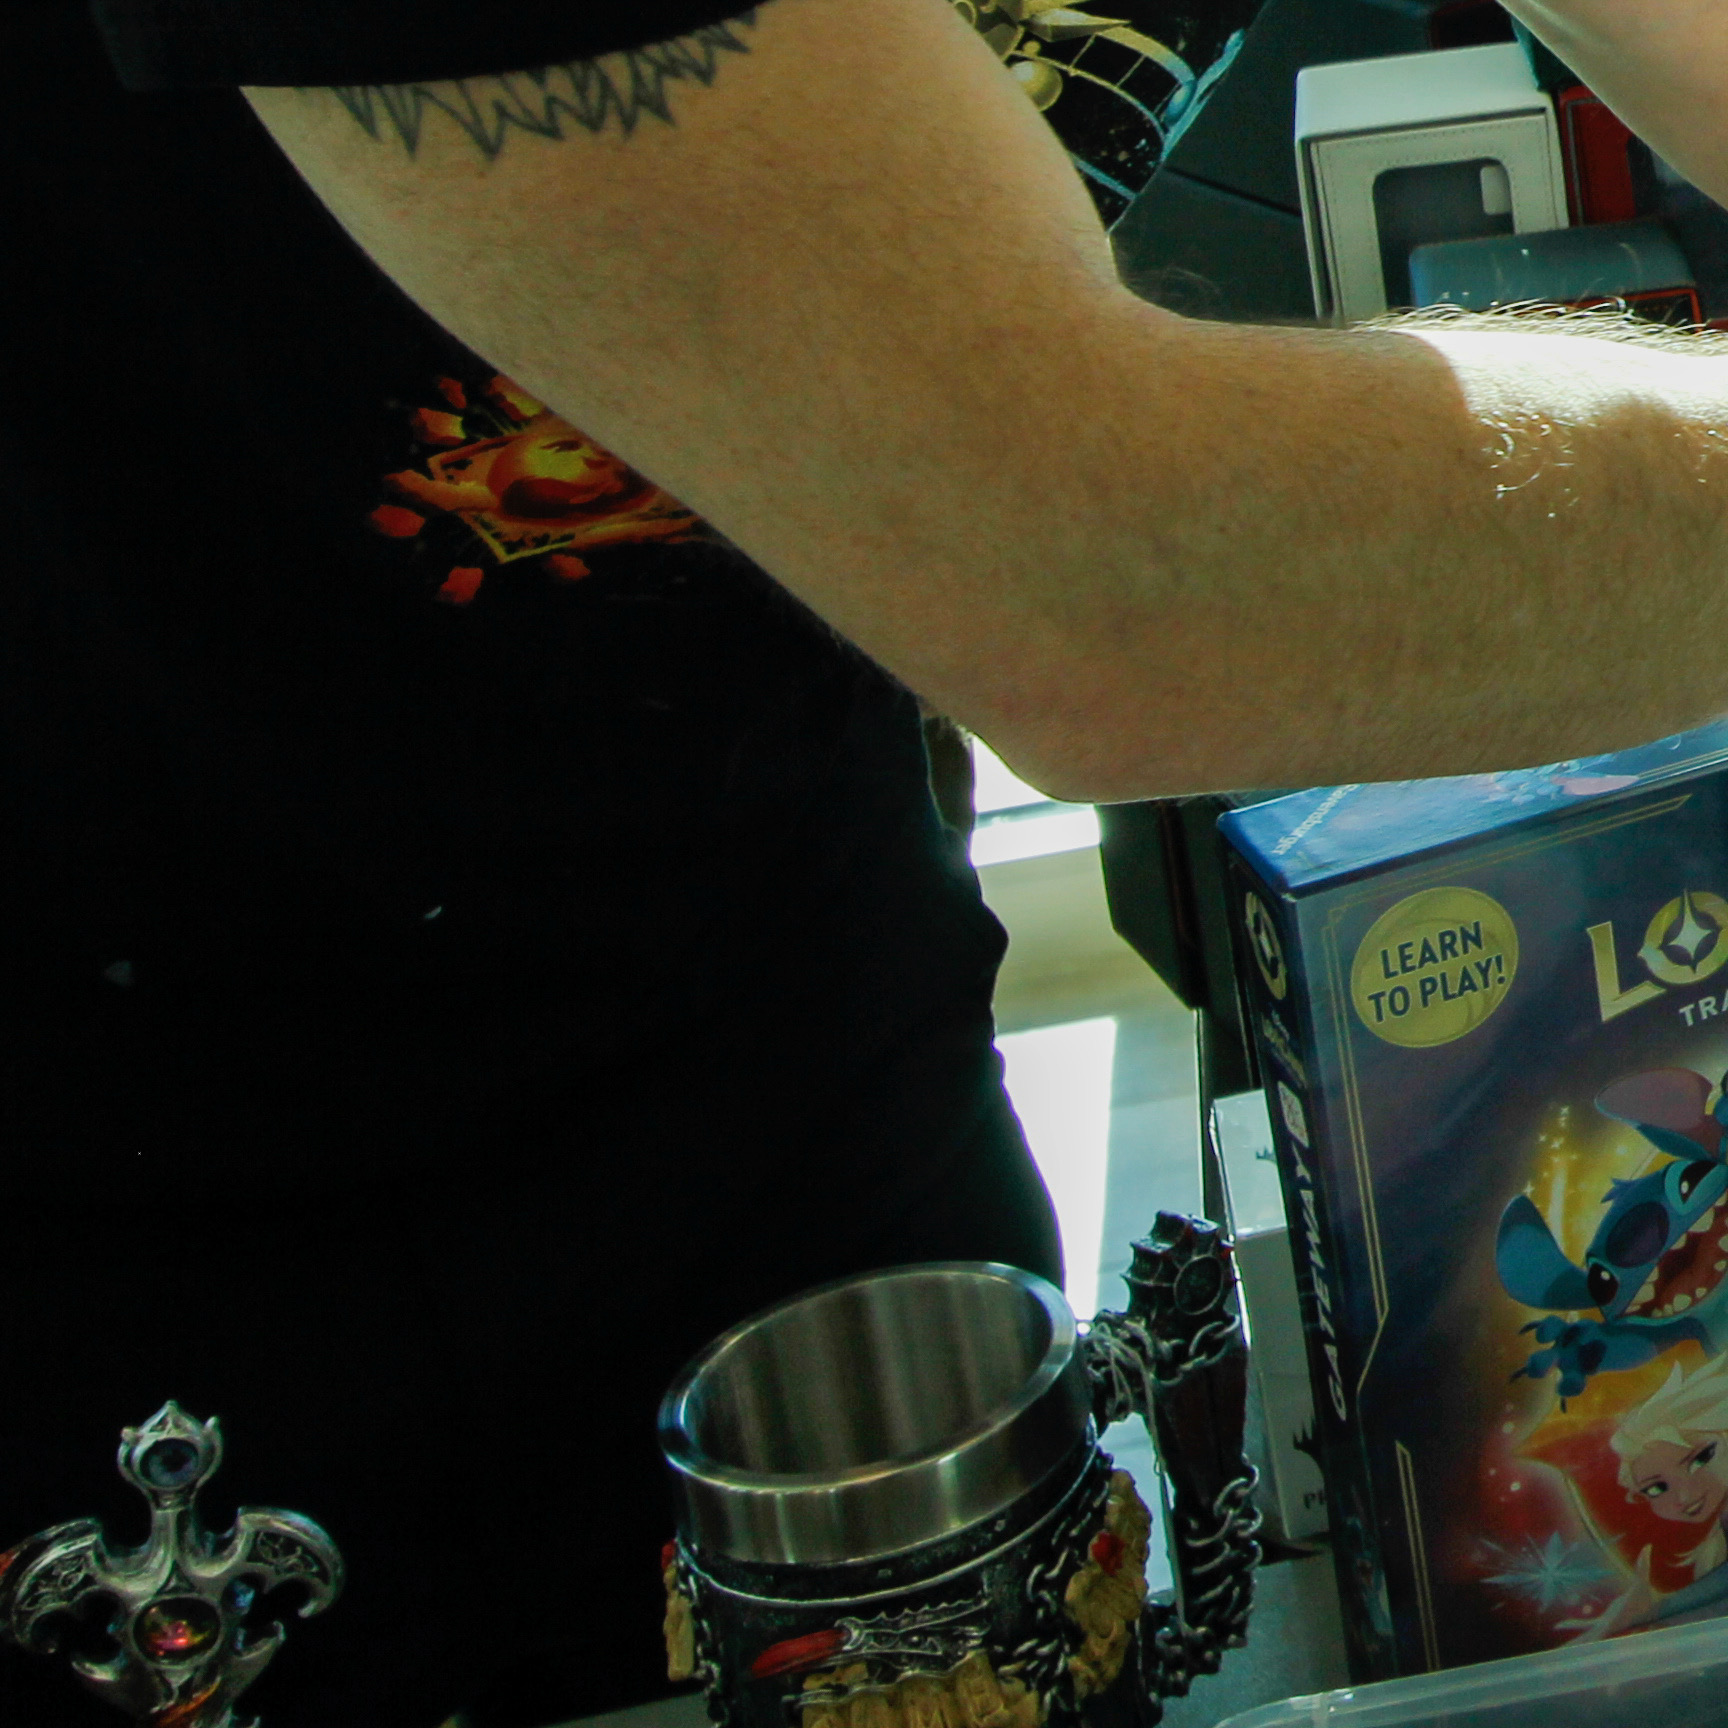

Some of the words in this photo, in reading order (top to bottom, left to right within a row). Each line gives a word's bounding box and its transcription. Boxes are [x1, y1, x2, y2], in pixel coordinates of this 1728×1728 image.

[1380, 920, 1483, 980] LEARN
[1367, 985, 1411, 1023] TO
[1418, 953, 1507, 1009] PLAY!
[1290, 1139, 1348, 1422] GATEWAY
